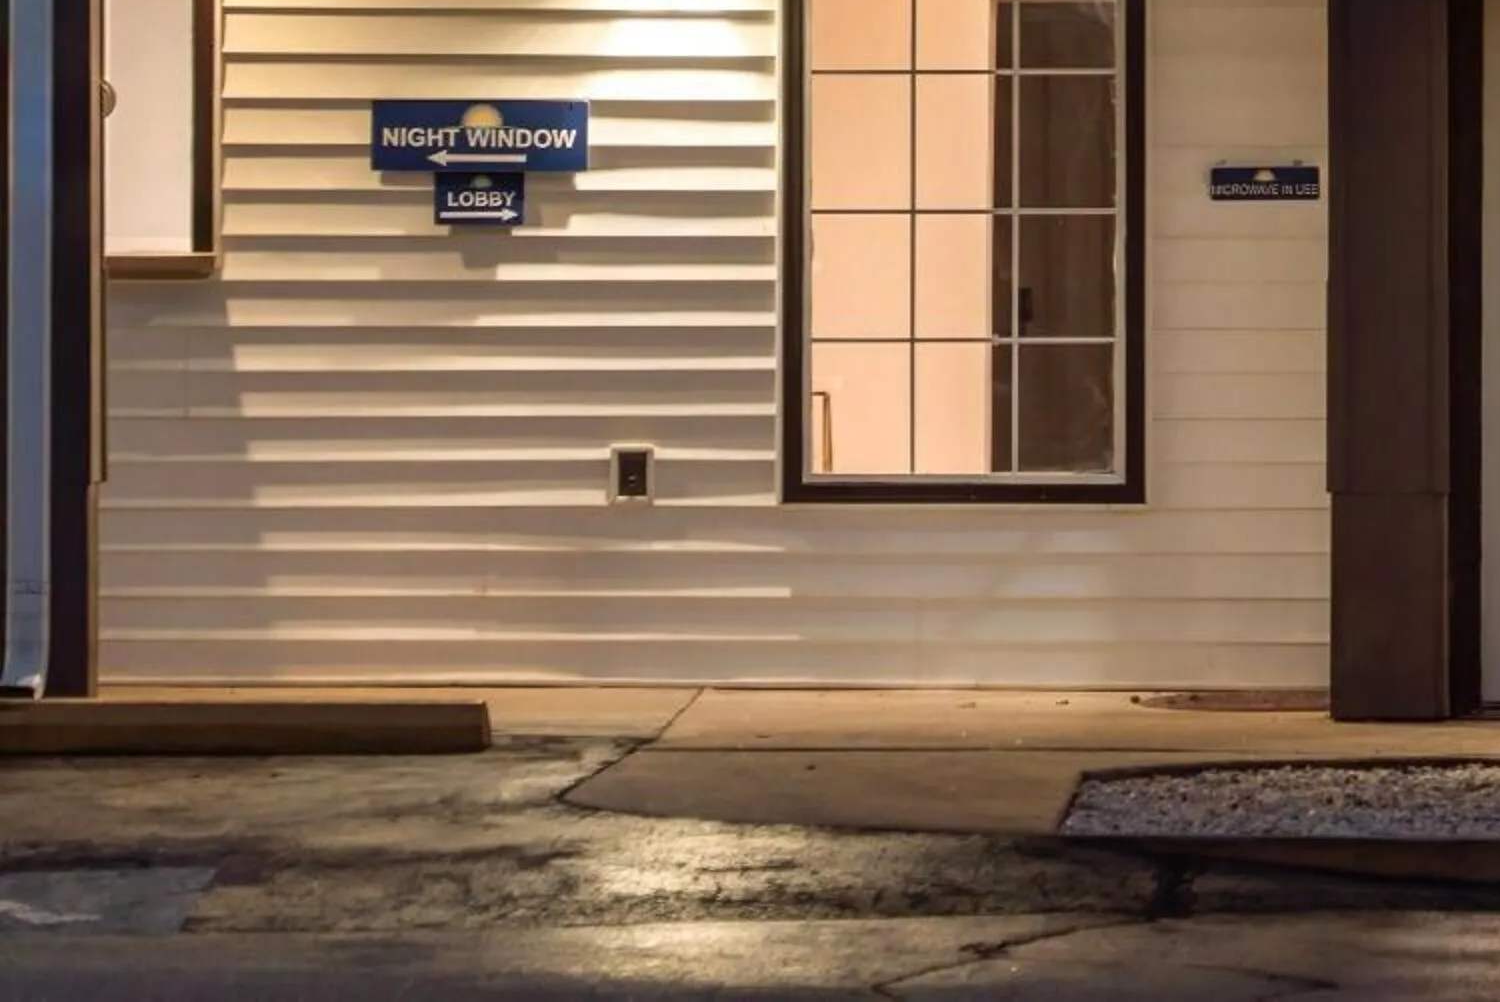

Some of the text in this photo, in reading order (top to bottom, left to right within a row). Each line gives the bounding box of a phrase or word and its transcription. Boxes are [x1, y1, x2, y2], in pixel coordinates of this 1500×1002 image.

[382, 127, 578, 148] NIGHT WINDOW
[447, 191, 517, 207] LOBBY
